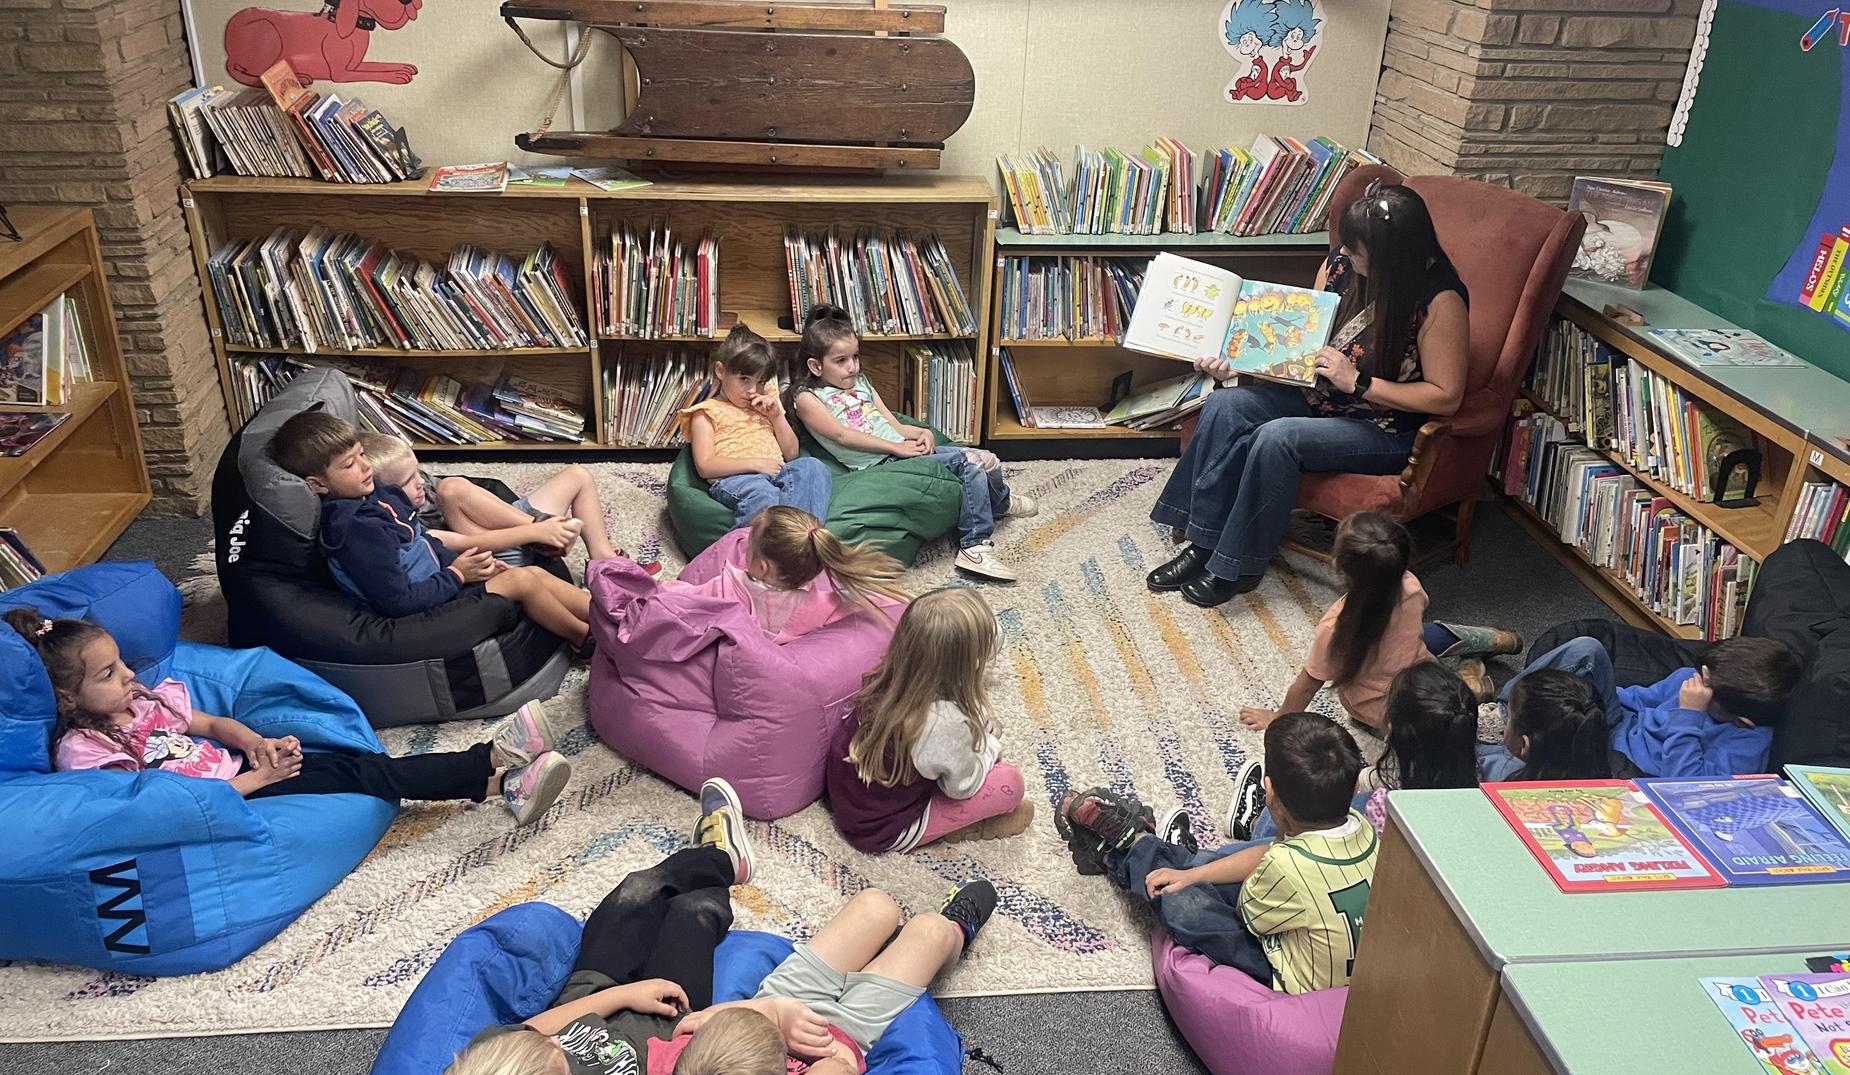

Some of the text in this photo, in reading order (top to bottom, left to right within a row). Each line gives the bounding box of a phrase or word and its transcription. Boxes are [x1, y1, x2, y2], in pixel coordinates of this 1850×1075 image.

[1812, 451, 1822, 463] M
[228, 536, 247, 564] Joe
[1731, 853, 1850, 866] FEELING AFRAID
[1573, 860, 1693, 874] FEELING ANGRY
[1741, 987, 1753, 1001] 1
[1796, 983, 1811, 998] 1
[1824, 983, 1849, 994] Can
[1787, 1001, 1845, 1020] Pete
[1813, 1021, 1846, 1033] Not
